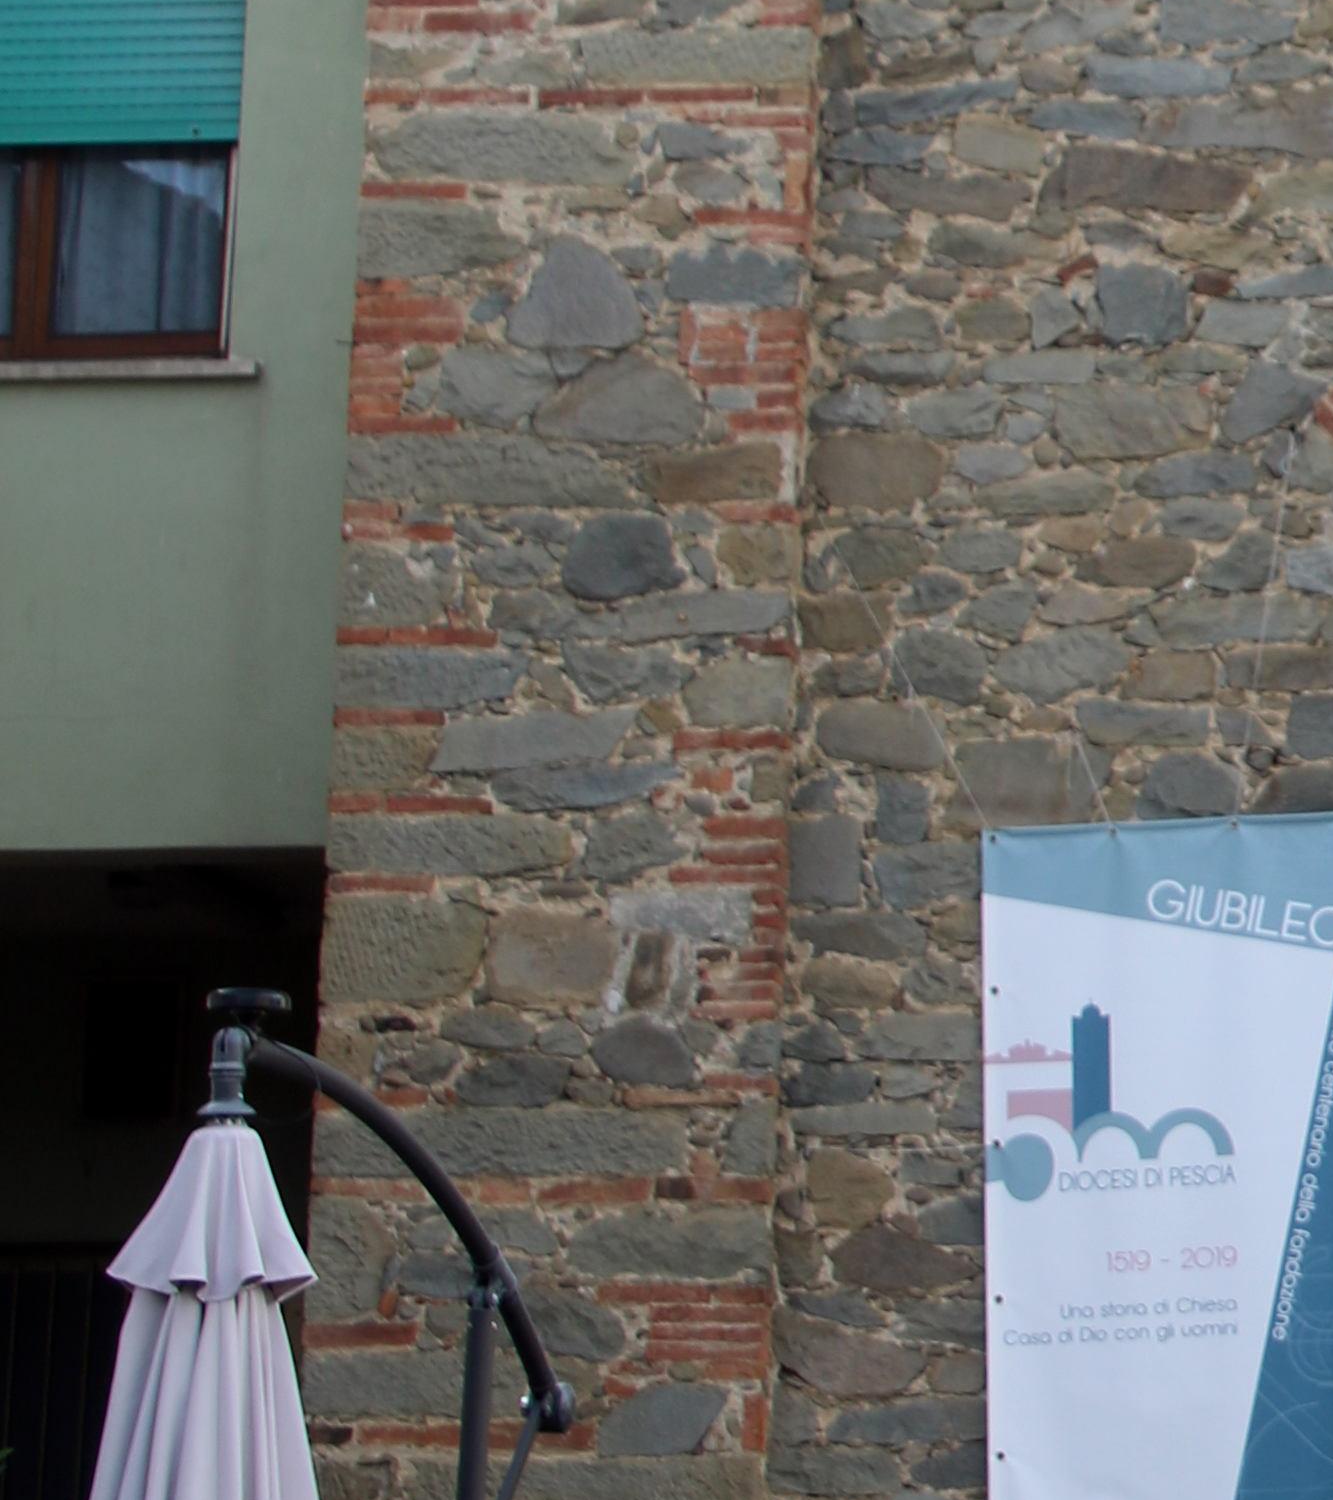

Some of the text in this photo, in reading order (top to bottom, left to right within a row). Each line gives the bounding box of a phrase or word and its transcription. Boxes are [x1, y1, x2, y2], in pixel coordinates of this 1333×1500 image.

[1058, 1163, 1237, 1193] DIOCESI DI PESCIA
[1294, 1172, 1320, 1223] della
[1105, 1249, 1152, 1273] 1519
[1180, 1245, 1238, 1269] 2019
[1271, 1229, 1311, 1342] fondazione
[1060, 1296, 1238, 1320] Una storia di Chiesa
[1003, 1321, 1238, 1346] Casa di Dio con gli uomini
